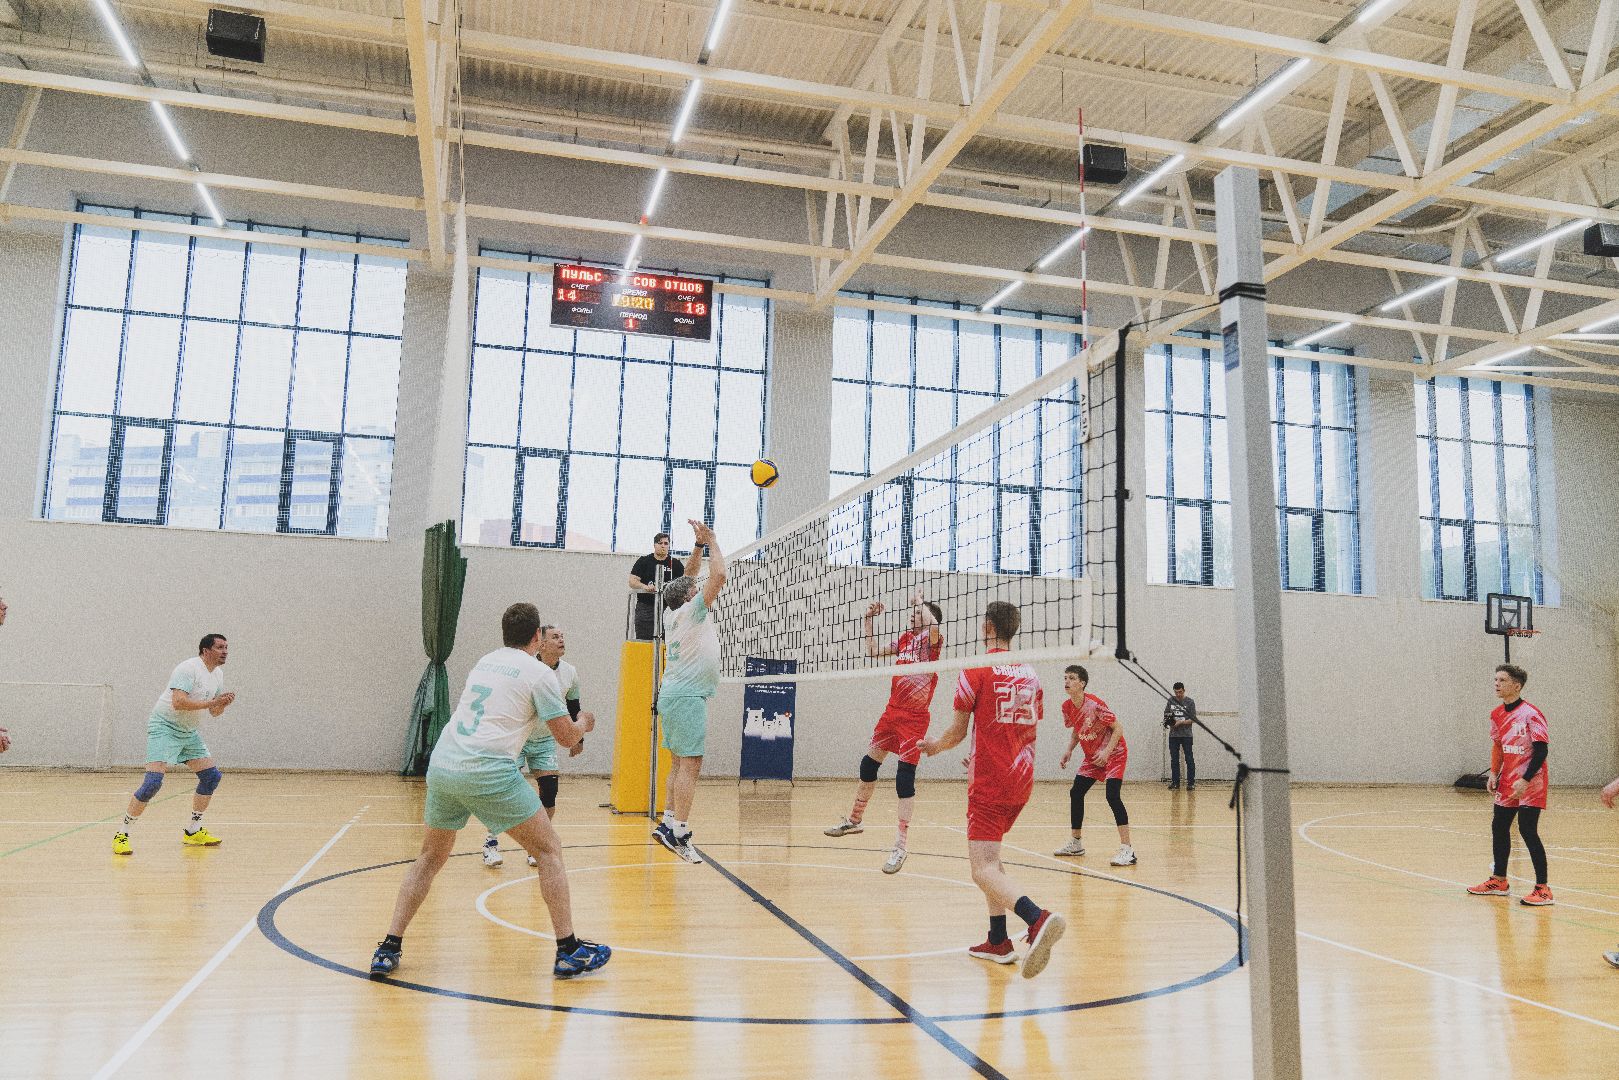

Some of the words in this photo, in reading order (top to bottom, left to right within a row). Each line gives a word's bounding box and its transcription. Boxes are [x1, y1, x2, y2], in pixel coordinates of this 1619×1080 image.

[562, 269, 602, 281] ПУЛЬС
[664, 280, 704, 293] ОТЦОВ
[558, 288, 577, 301] 14
[677, 294, 696, 302] СЧЕТ
[686, 302, 705, 315] 18
[619, 311, 648, 320] ПЕРИОД
[673, 317, 695, 325] ФОЛЫ
[628, 318, 634, 328] 1
[992, 681, 1037, 726] 23
[457, 684, 493, 737] 3
